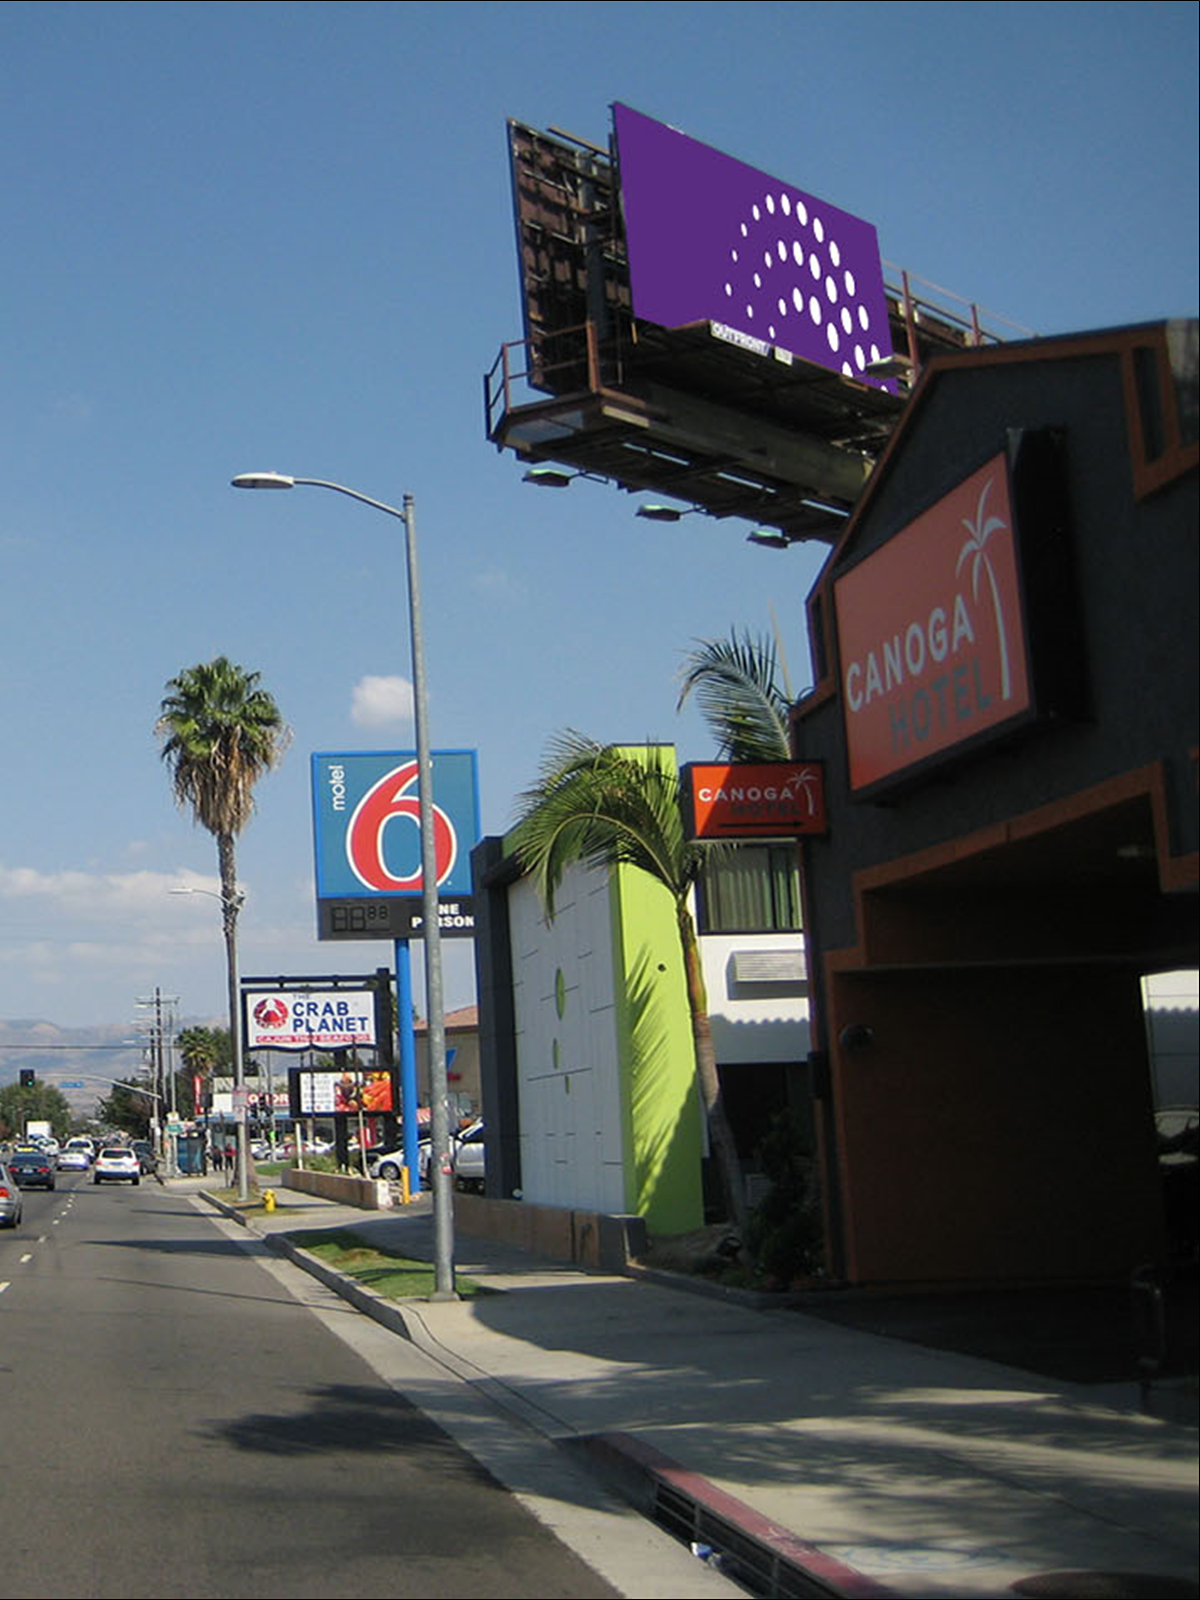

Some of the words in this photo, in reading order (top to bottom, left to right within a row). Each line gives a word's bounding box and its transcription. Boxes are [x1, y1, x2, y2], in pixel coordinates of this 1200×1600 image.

[846, 592, 975, 713] CANOGA
[888, 655, 994, 756] HOTEL
[328, 765, 346, 811] motel
[698, 786, 795, 802] CANOGA
[345, 758, 457, 892] 6
[436, 904, 460, 915] NE
[411, 916, 475, 928] PSON
[292, 1001, 349, 1017] CRAB
[292, 1017, 369, 1032] PLANET
